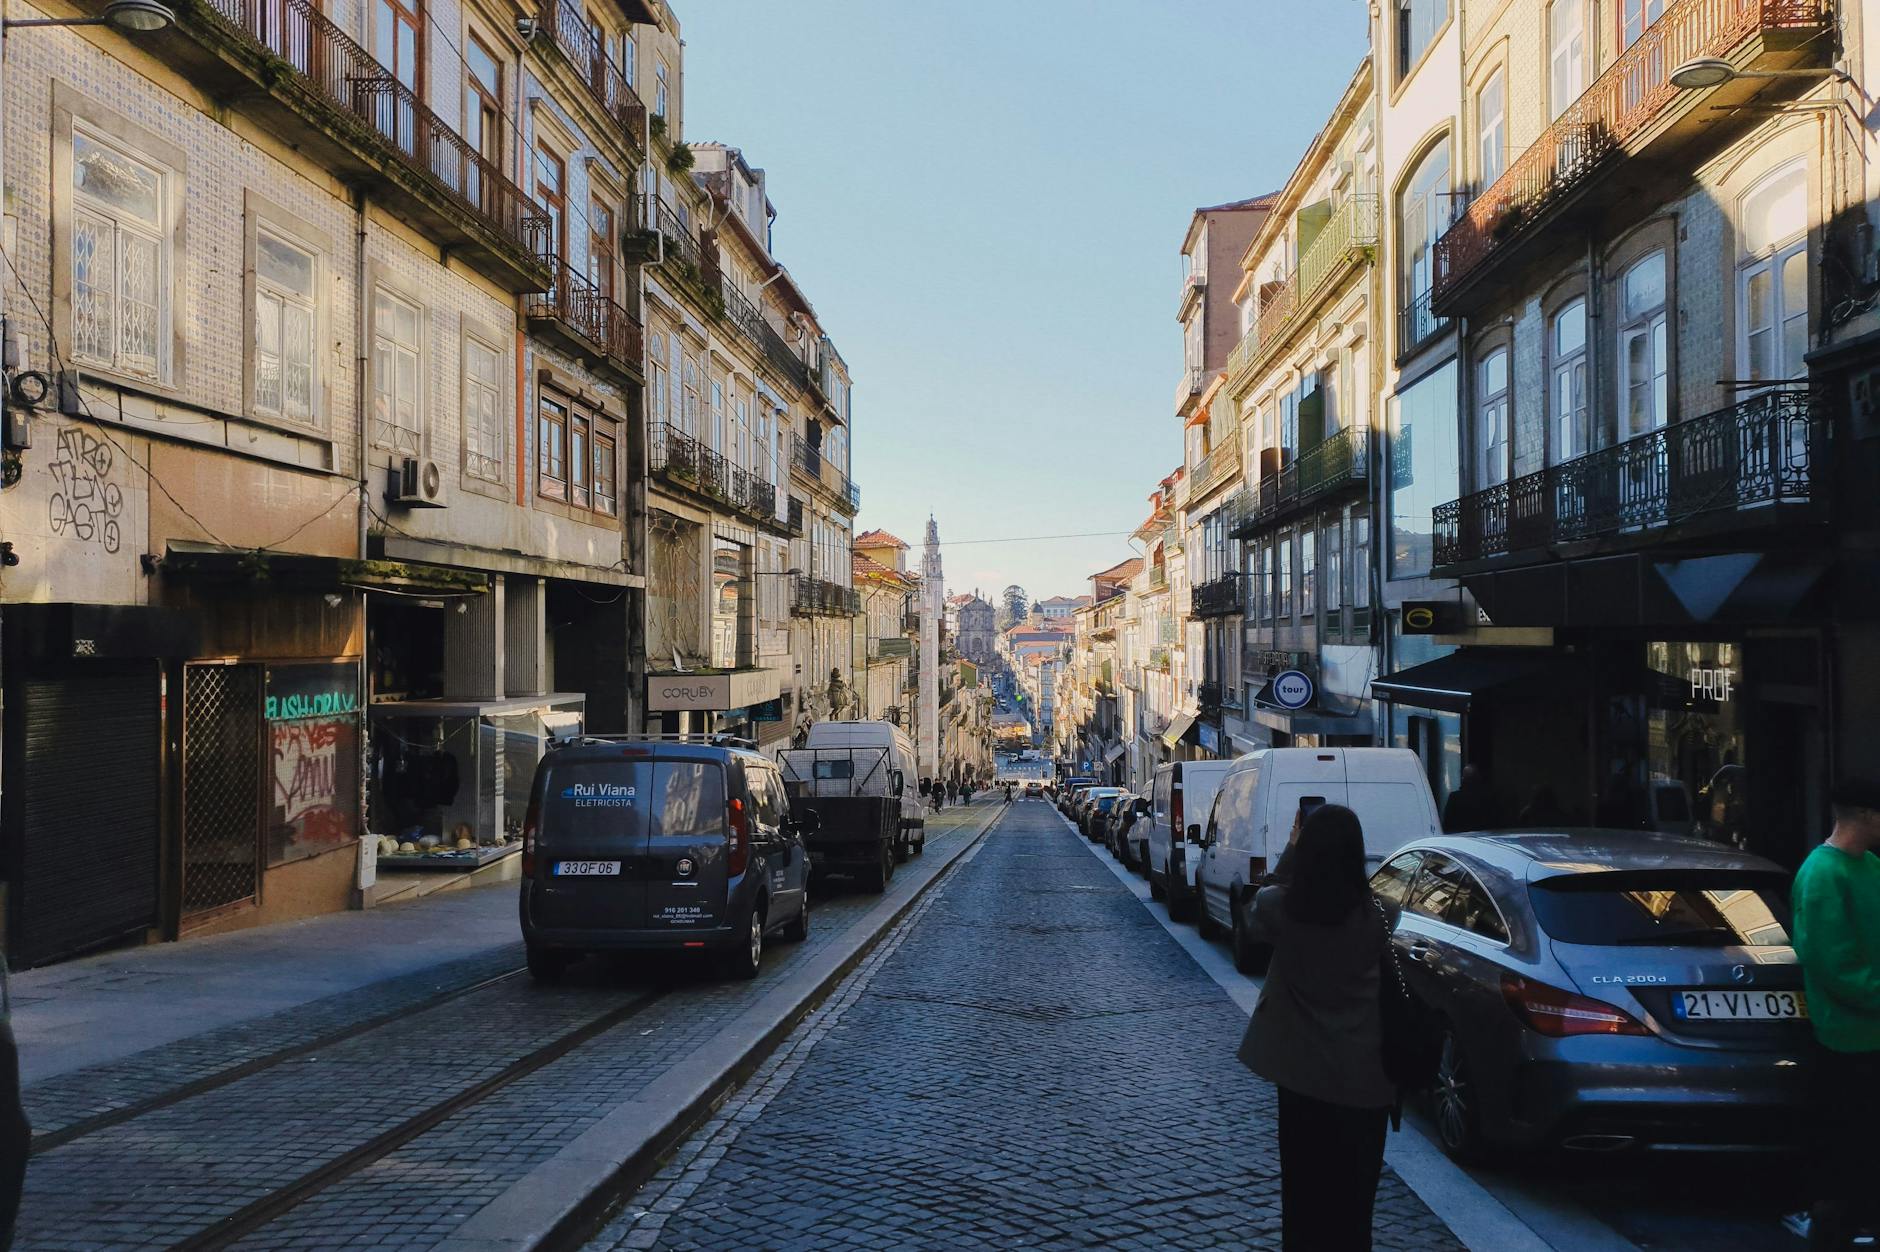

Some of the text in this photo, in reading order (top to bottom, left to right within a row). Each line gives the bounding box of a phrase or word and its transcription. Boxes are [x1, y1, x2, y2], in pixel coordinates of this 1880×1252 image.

[662, 685, 716, 701] CORUBY
[1282, 685, 1304, 694] tour
[1083, 761, 1090, 770] P
[574, 783, 636, 796] Rui Viana
[575, 799, 632, 807] ELETRICISTA
[1626, 975, 1667, 983] 200d
